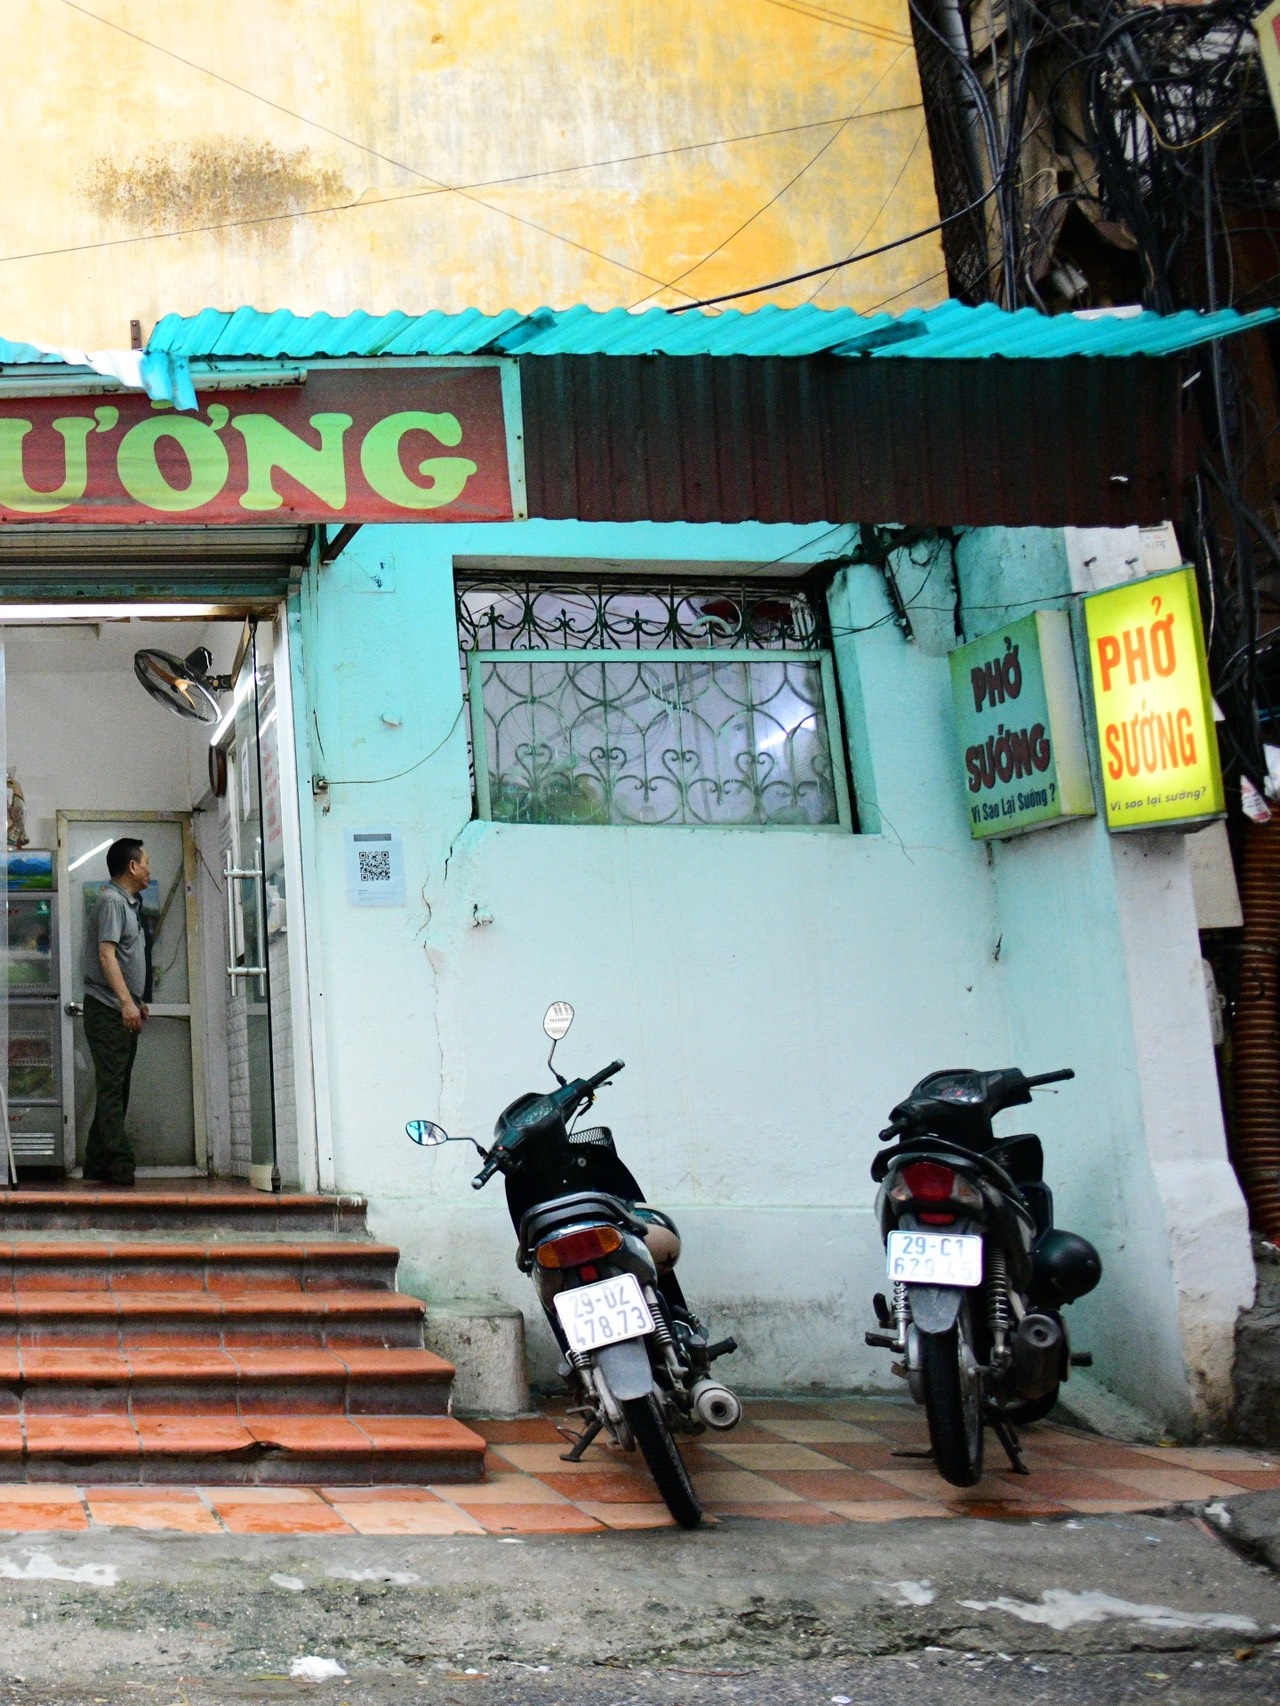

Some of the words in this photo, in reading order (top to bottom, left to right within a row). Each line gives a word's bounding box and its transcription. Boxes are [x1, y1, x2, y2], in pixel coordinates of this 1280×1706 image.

[1096, 595, 1176, 692] PHỞ
[971, 636, 1023, 713] PHỞ
[965, 723, 1051, 794] SƯỚNG
[1104, 699, 1198, 781] SƯỚNG
[983, 799, 1001, 821] Sao
[1001, 795, 1016, 819] Lại
[1018, 786, 1048, 812] Sướng
[1125, 798, 1143, 809] sao
[1147, 795, 1162, 807] lại
[1165, 786, 1207, 802] sướng?
[902, 1235, 964, 1258] 29-C1
[574, 1306, 646, 1346] 478.73
